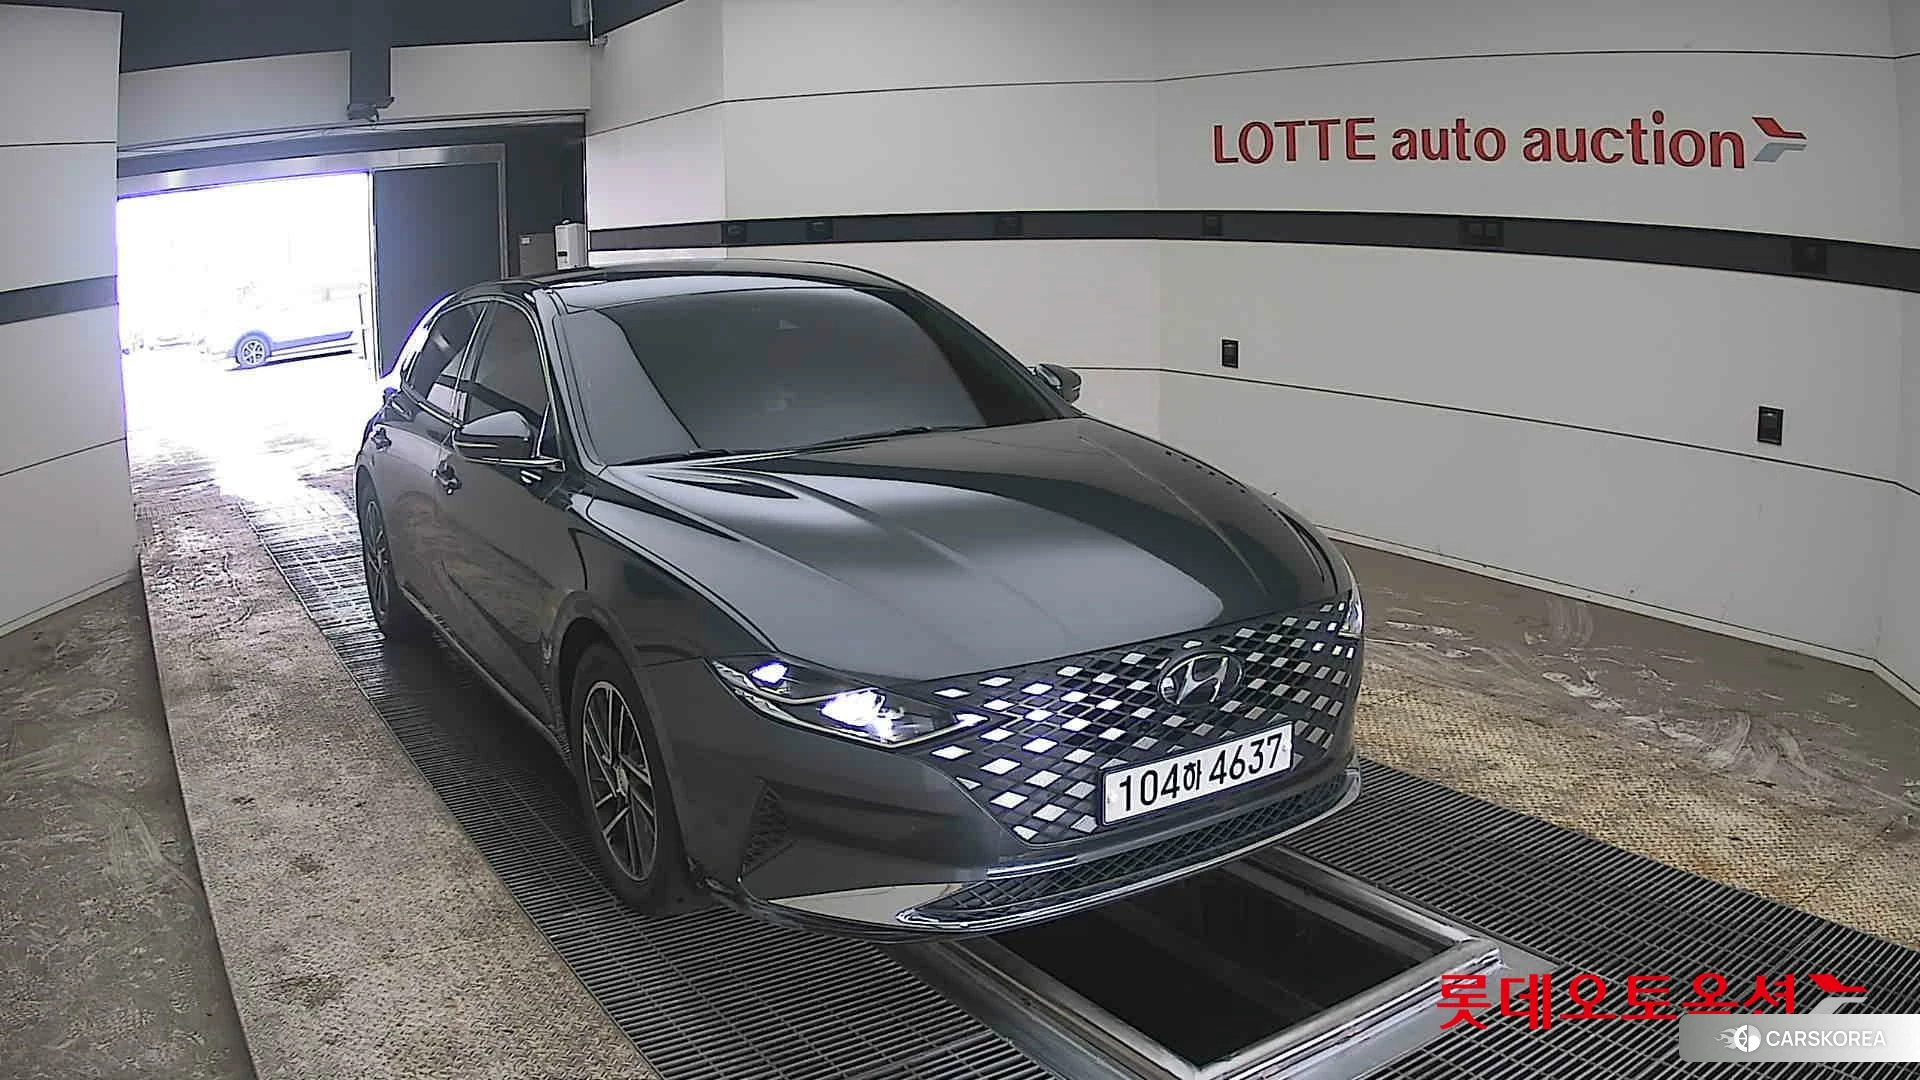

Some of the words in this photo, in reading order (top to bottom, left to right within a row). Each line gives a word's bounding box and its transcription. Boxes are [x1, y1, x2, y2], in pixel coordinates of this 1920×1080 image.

[1213, 117, 1376, 164] LOTTE
[1392, 118, 1507, 162] auto
[1523, 111, 1746, 169] auction
[1119, 760, 1202, 812] 104하
[1208, 732, 1284, 785] 4637
